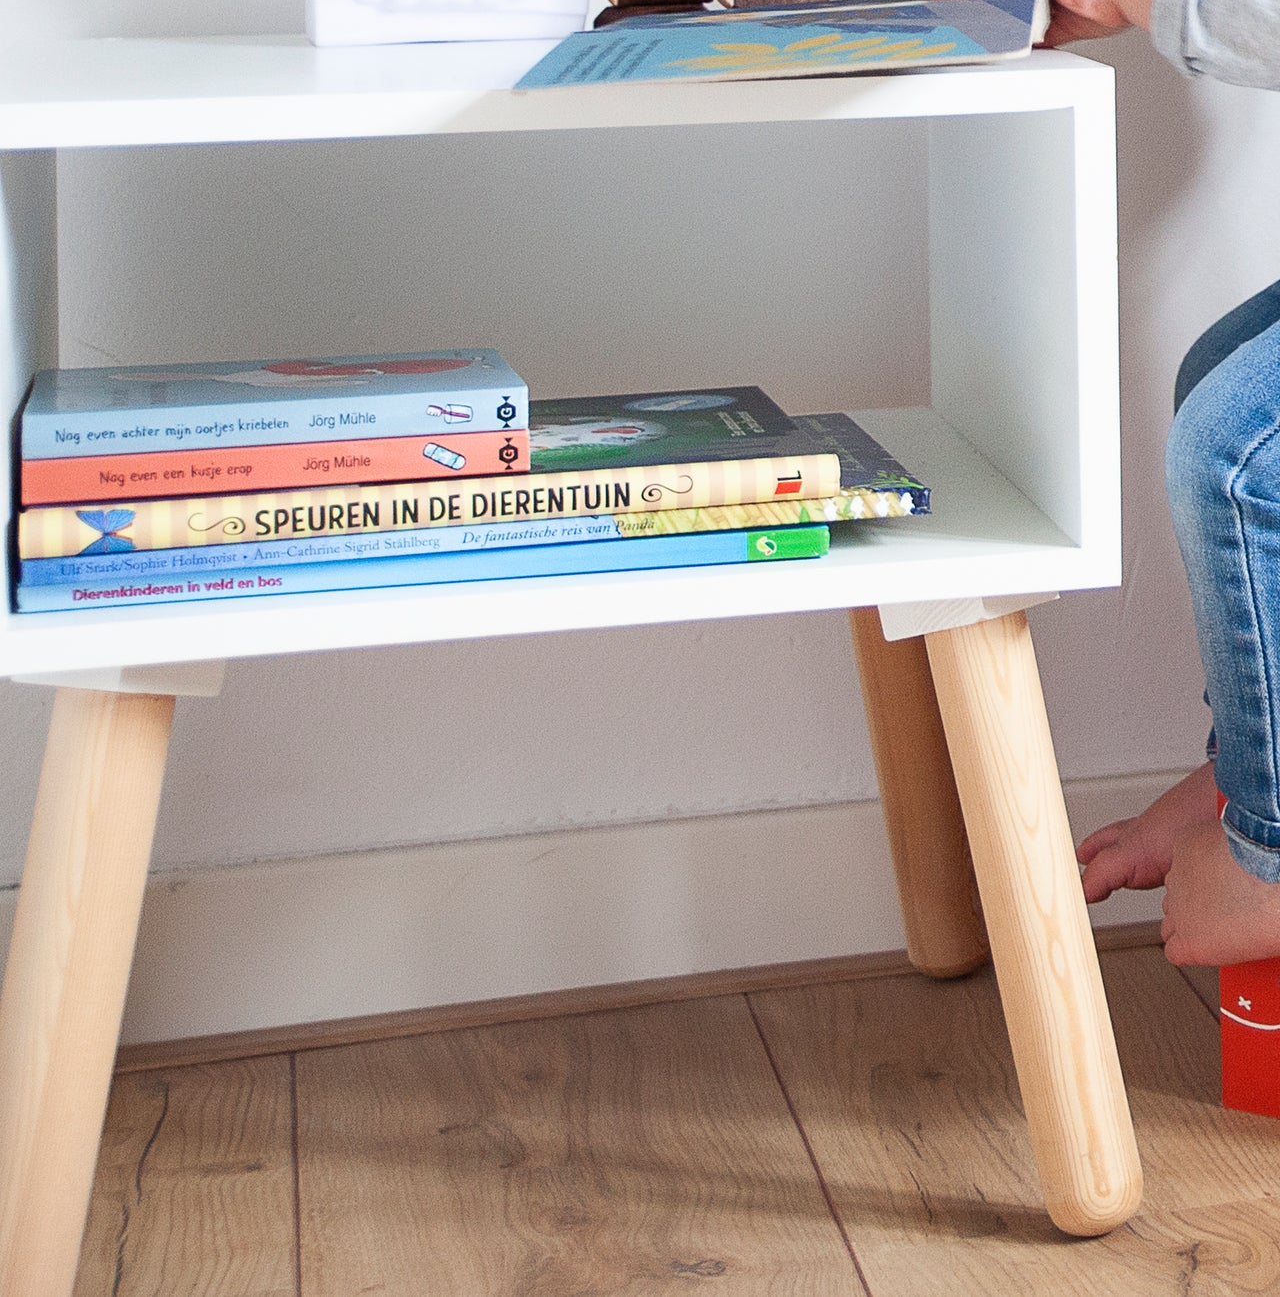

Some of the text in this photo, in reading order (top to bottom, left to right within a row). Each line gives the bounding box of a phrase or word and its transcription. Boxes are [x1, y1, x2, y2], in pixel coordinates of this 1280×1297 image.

[87, 430, 116, 440] even
[121, 424, 160, 438] achter
[238, 417, 290, 432] kriebelen
[308, 410, 377, 433] Jörg Mühle
[130, 472, 158, 482] even
[163, 470, 185, 480] een
[190, 463, 222, 481] kusje
[302, 453, 371, 473] Jörg Mühle
[254, 481, 632, 537] SPEUREN IN DE DIERENTUIN
[461, 516, 656, 547] De fantastische reis van Panda
[171, 552, 237, 570] Holmqvist
[254, 544, 341, 561] Ann-Cathrine
[344, 539, 380, 557] Sigrid
[72, 575, 284, 602] Dierenkinderen in veld en bos
